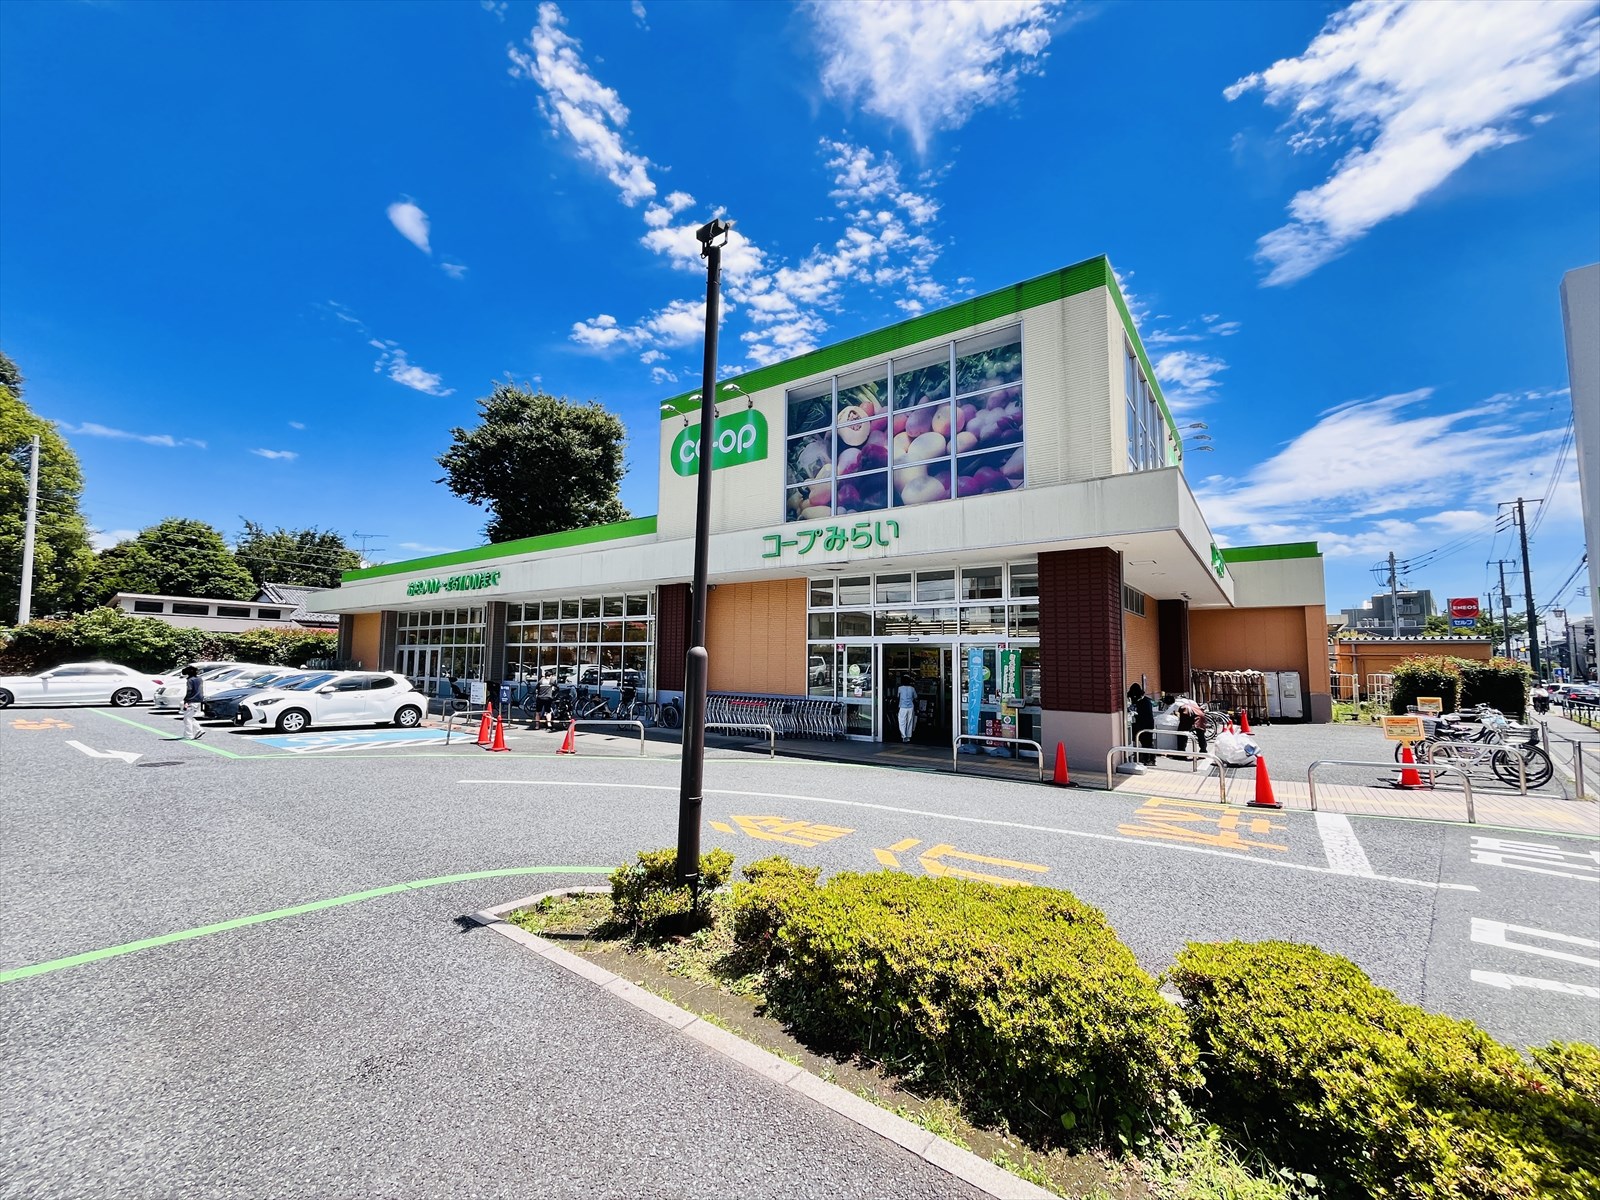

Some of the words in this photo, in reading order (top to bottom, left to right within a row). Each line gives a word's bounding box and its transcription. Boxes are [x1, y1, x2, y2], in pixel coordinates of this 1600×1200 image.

[762, 520, 899, 558] コープみらい
